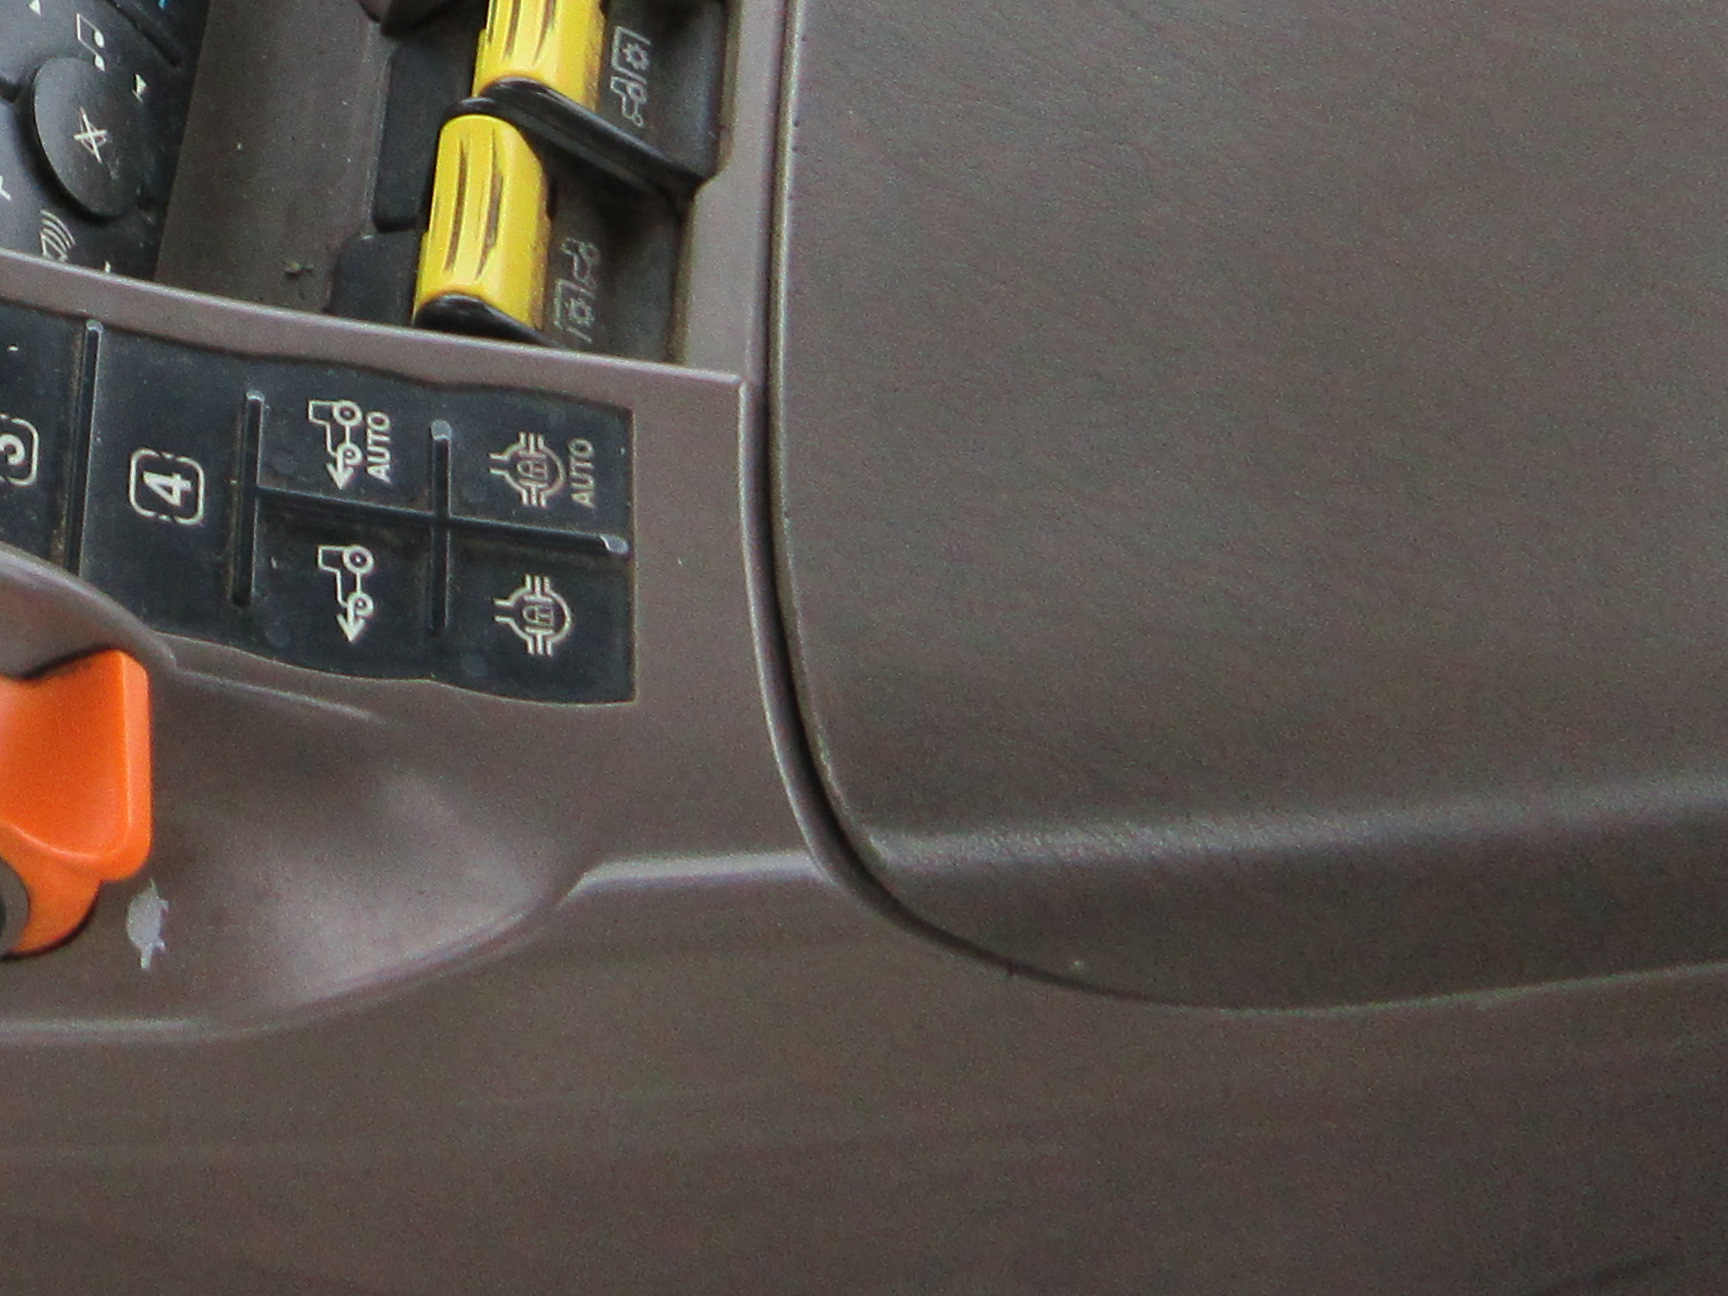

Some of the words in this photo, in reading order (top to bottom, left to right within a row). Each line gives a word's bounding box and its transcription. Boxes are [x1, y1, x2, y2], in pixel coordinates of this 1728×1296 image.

[365, 410, 392, 484] AUTO
[567, 437, 595, 508] AUTO
[142, 470, 193, 507] 4
